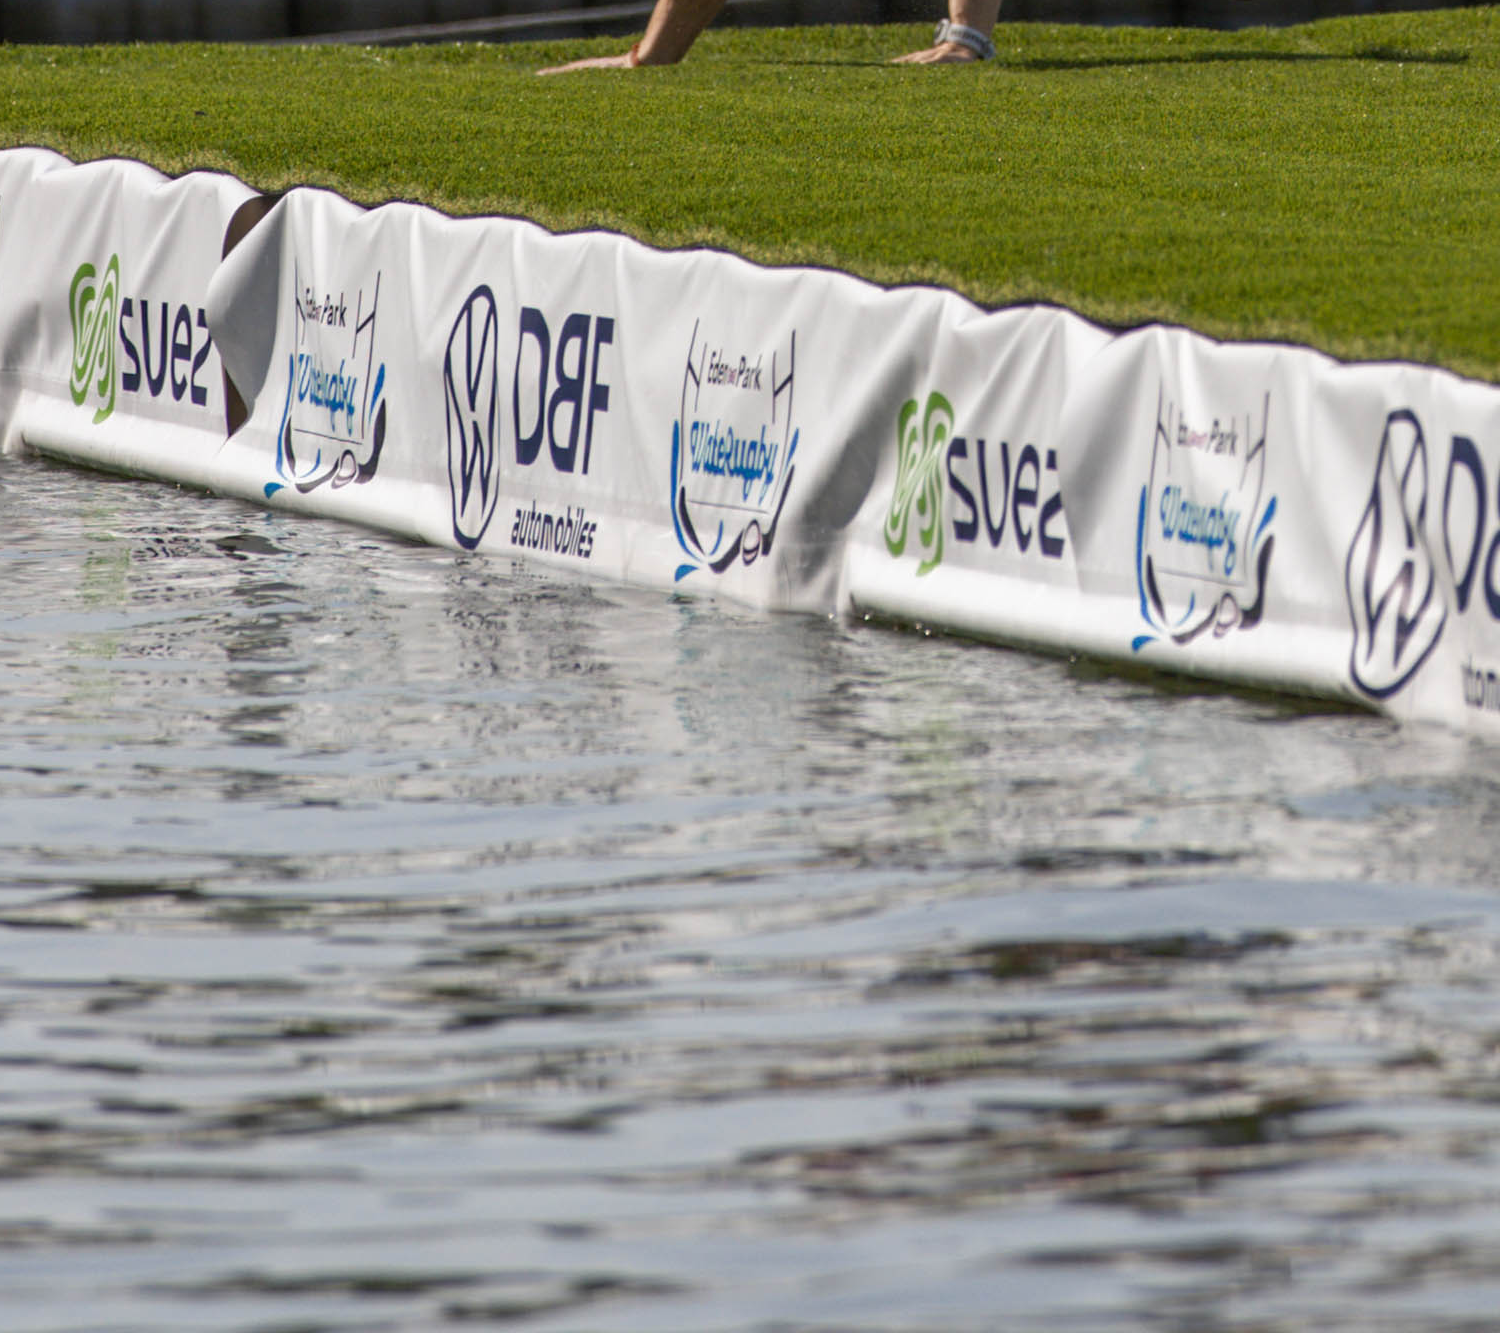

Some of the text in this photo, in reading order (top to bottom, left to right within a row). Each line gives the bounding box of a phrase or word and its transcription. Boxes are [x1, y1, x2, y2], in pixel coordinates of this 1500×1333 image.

[119, 297, 212, 407] suez
[320, 291, 347, 328] Park
[513, 307, 615, 475] DBF
[707, 348, 763, 391] Eden Park
[690, 419, 779, 507] WateRugby
[946, 437, 1065, 560] suez
[511, 499, 597, 559] automobiles
